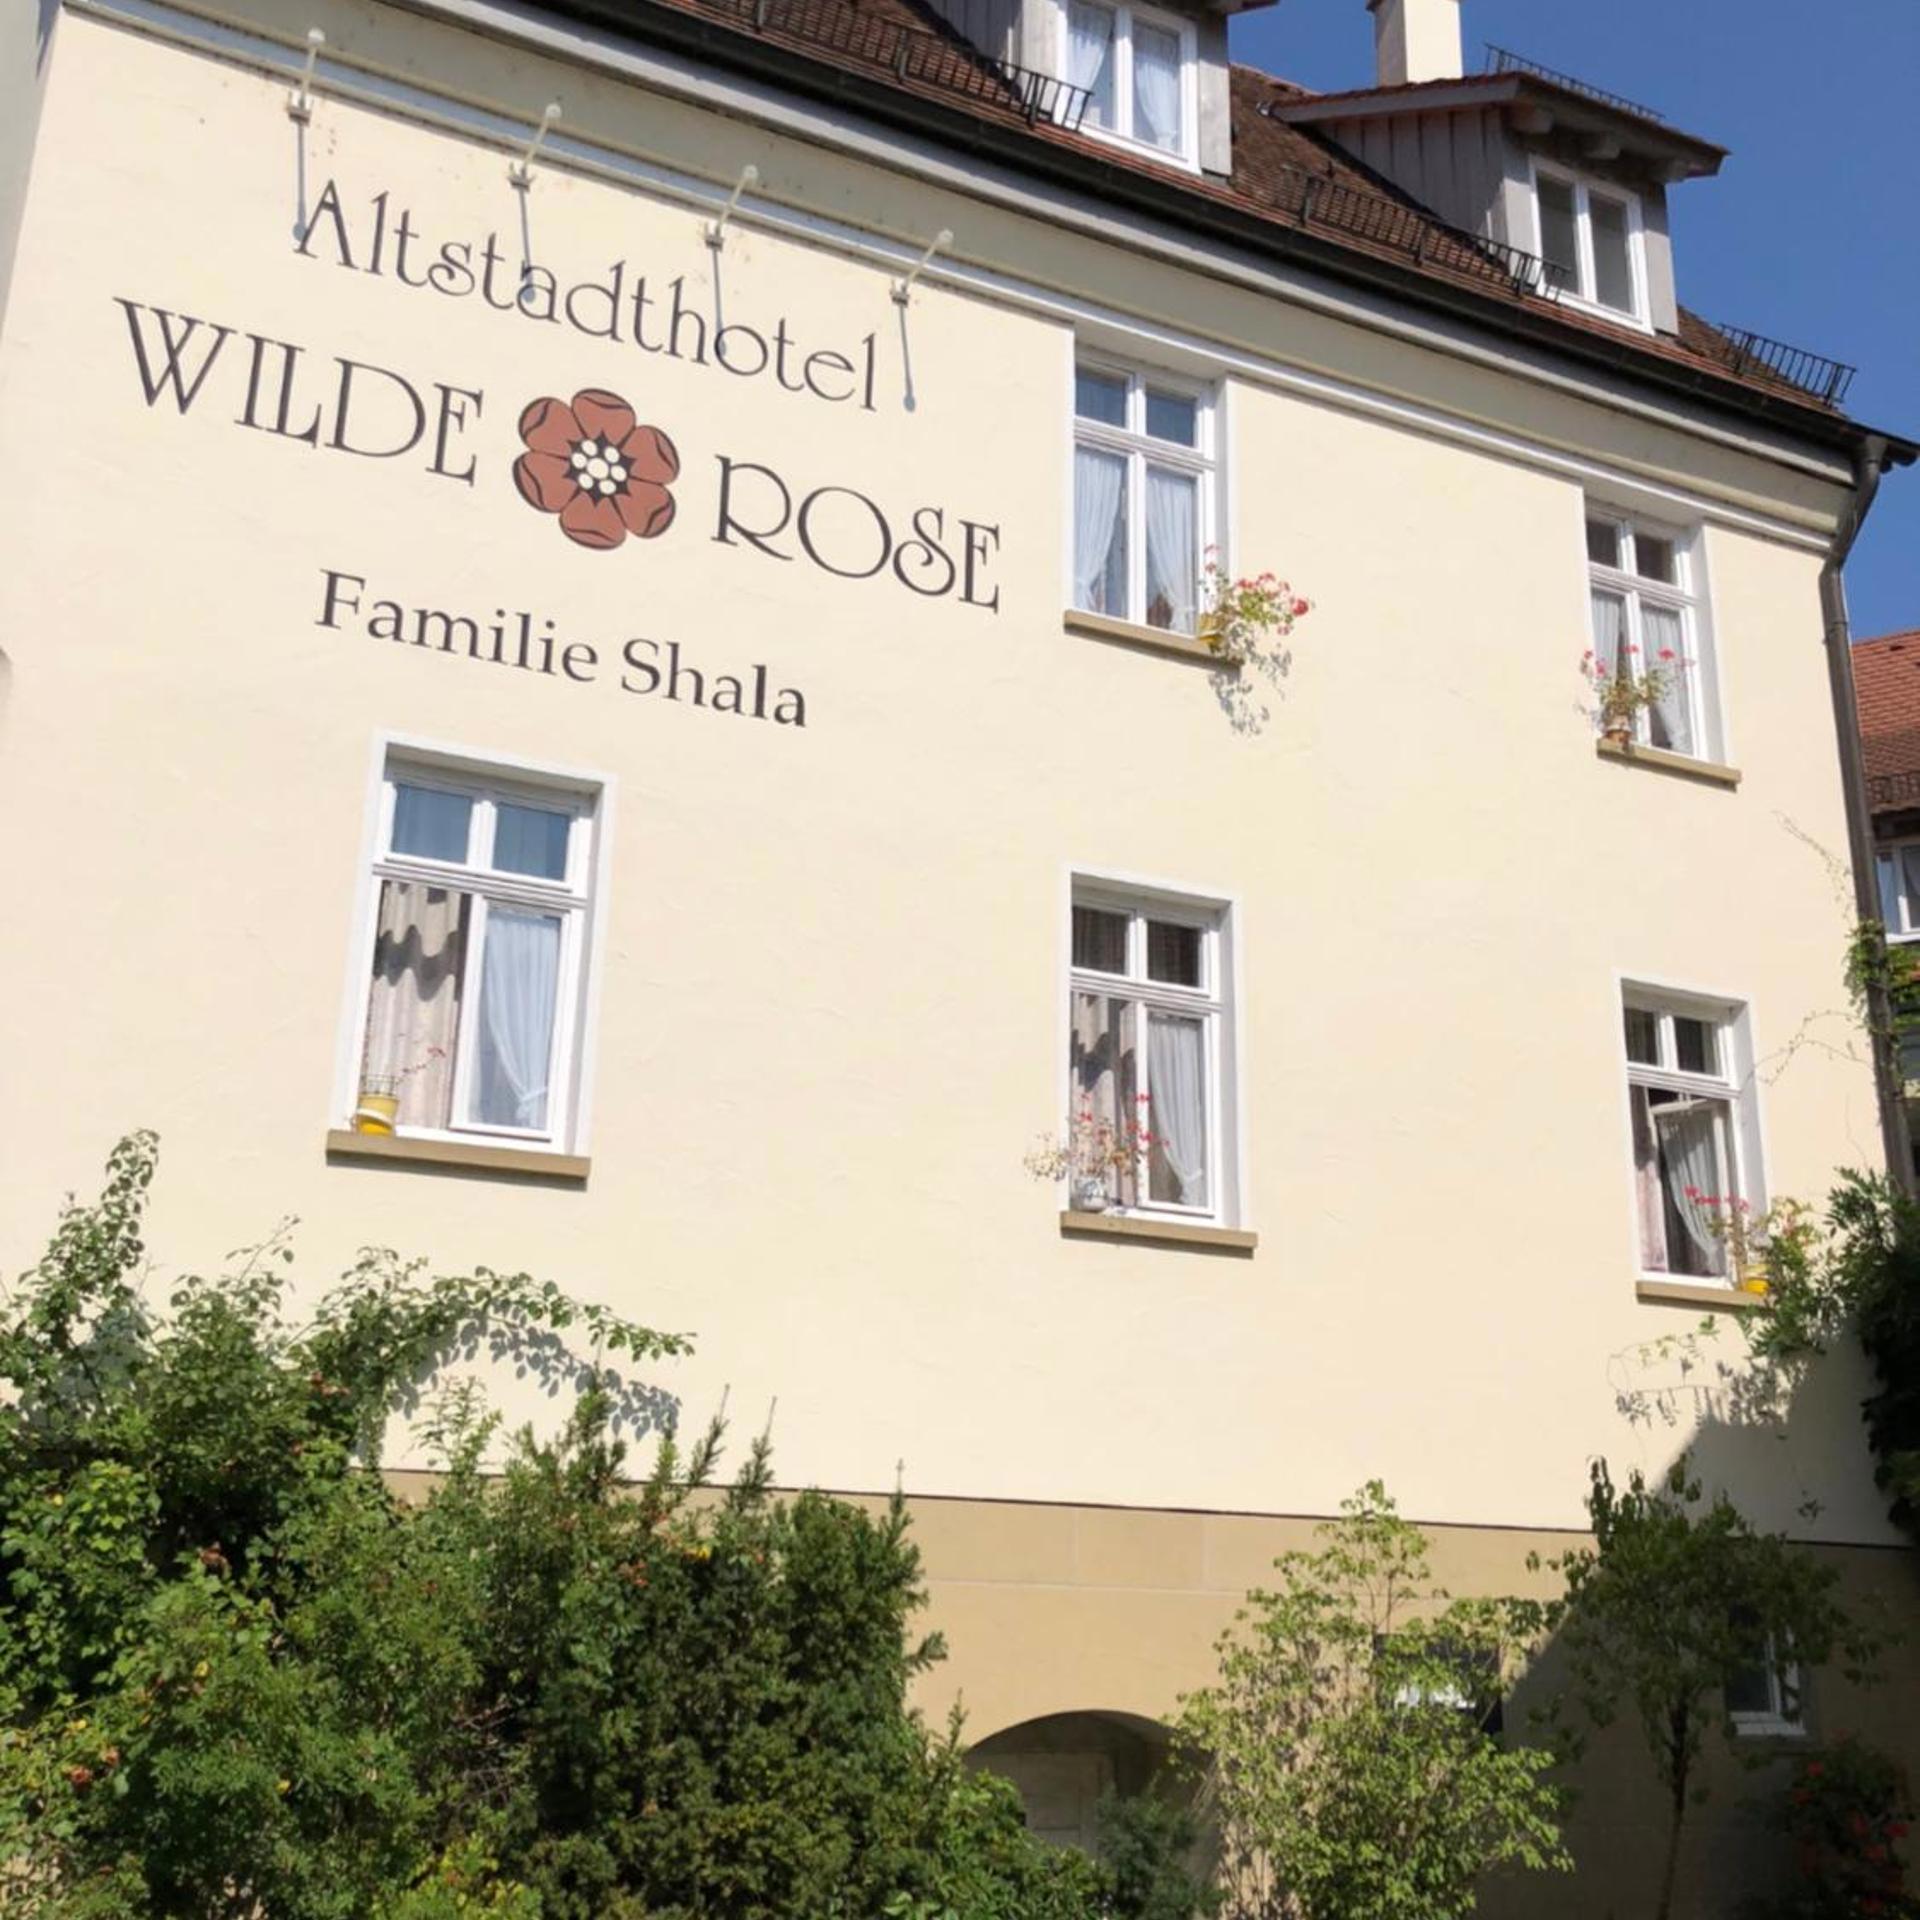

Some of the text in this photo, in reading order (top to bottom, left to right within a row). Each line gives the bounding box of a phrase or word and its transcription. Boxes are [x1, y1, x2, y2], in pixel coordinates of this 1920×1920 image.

[294, 179, 880, 412] Altstadthotel
[113, 297, 1001, 614] WILDE ROSE
[314, 569, 808, 728] Familie Shala
